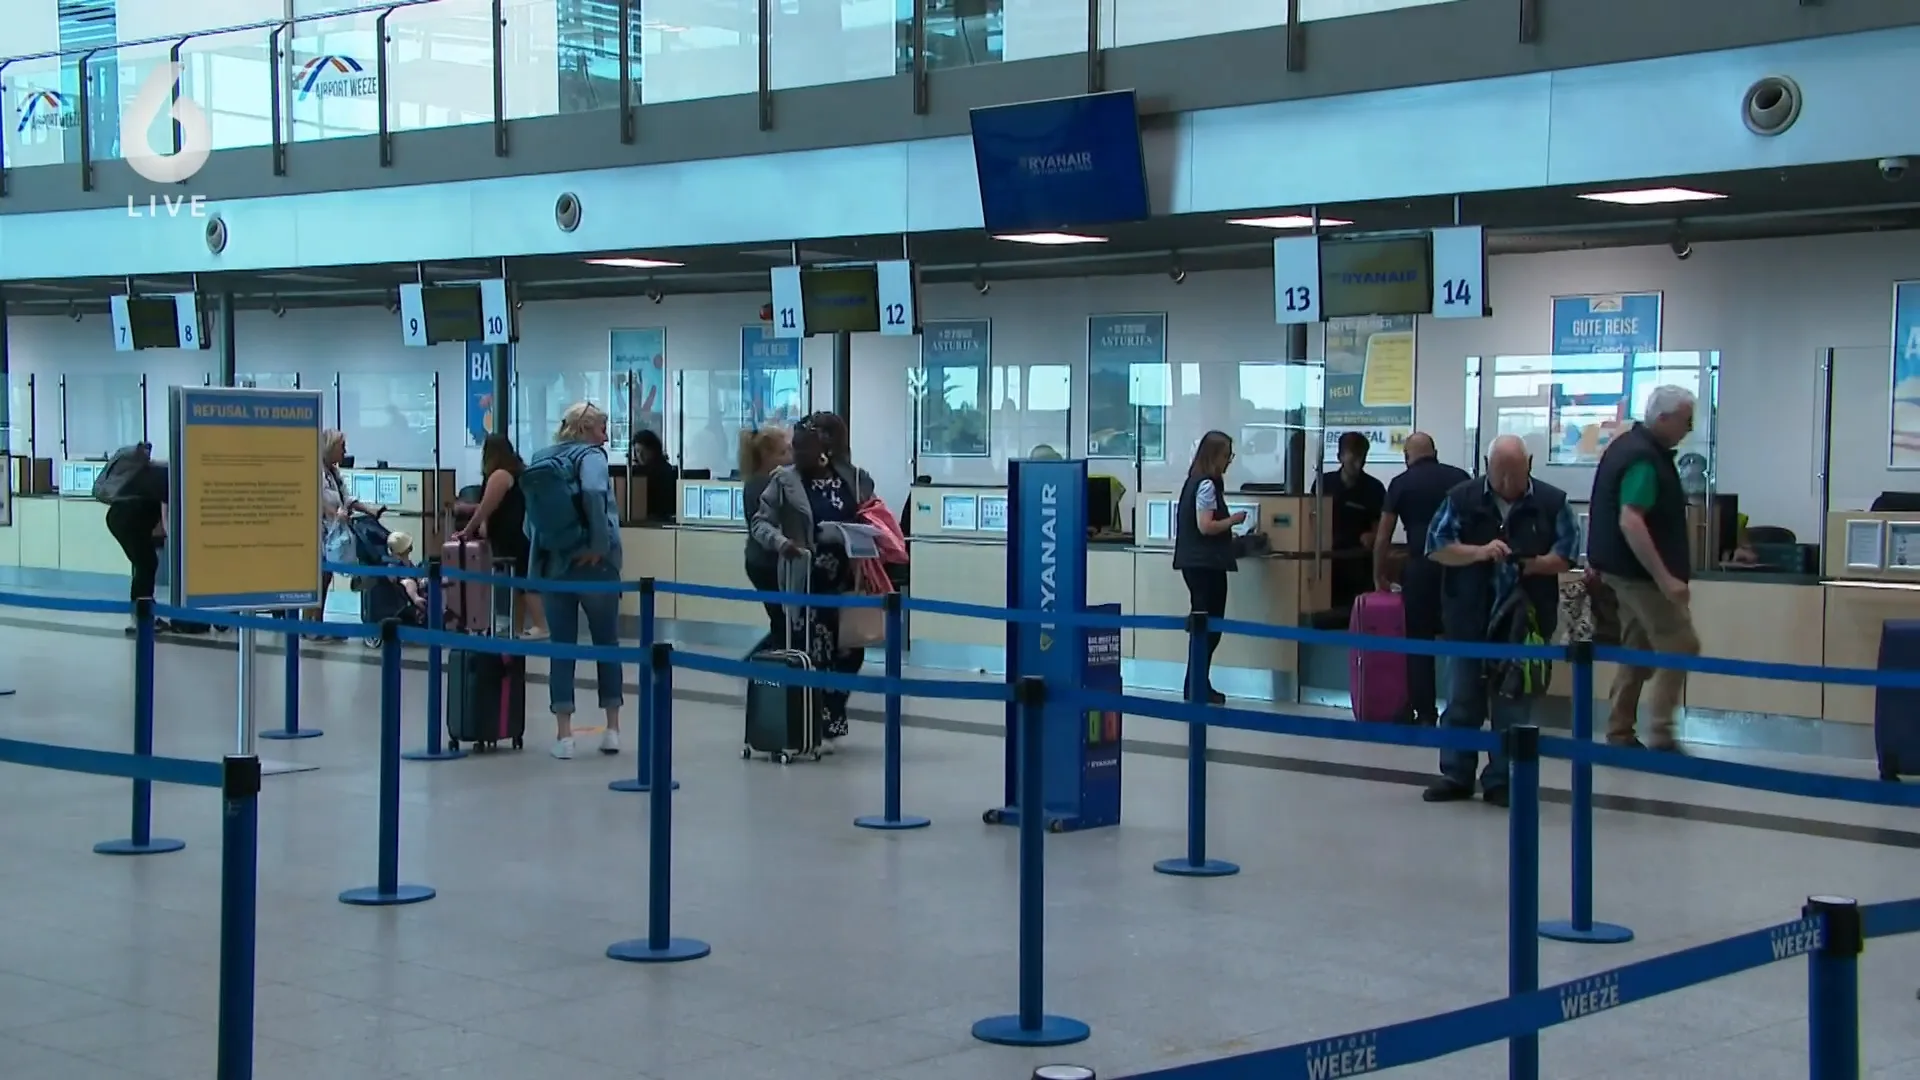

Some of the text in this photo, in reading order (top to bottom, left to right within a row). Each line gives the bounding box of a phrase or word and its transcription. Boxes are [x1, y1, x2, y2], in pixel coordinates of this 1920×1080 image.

[350, 76, 377, 97] WEEZE
[1028, 152, 1092, 171] RYANAIR
[1284, 286, 1311, 312] 13
[1442, 278, 1472, 306] 14
[780, 307, 797, 328] 11
[886, 303, 905, 325] 12
[119, 327, 126, 344] 7
[184, 325, 193, 342] 8
[409, 318, 418, 337] 9
[488, 315, 503, 335] 10
[1572, 317, 1640, 337] GUTE REISE
[193, 403, 313, 420] REFUSAL TO BOARD
[1771, 929, 1822, 960] WEEZE
[1561, 985, 1620, 1019] WEEZE
[1306, 1045, 1378, 1080] WEEZE
